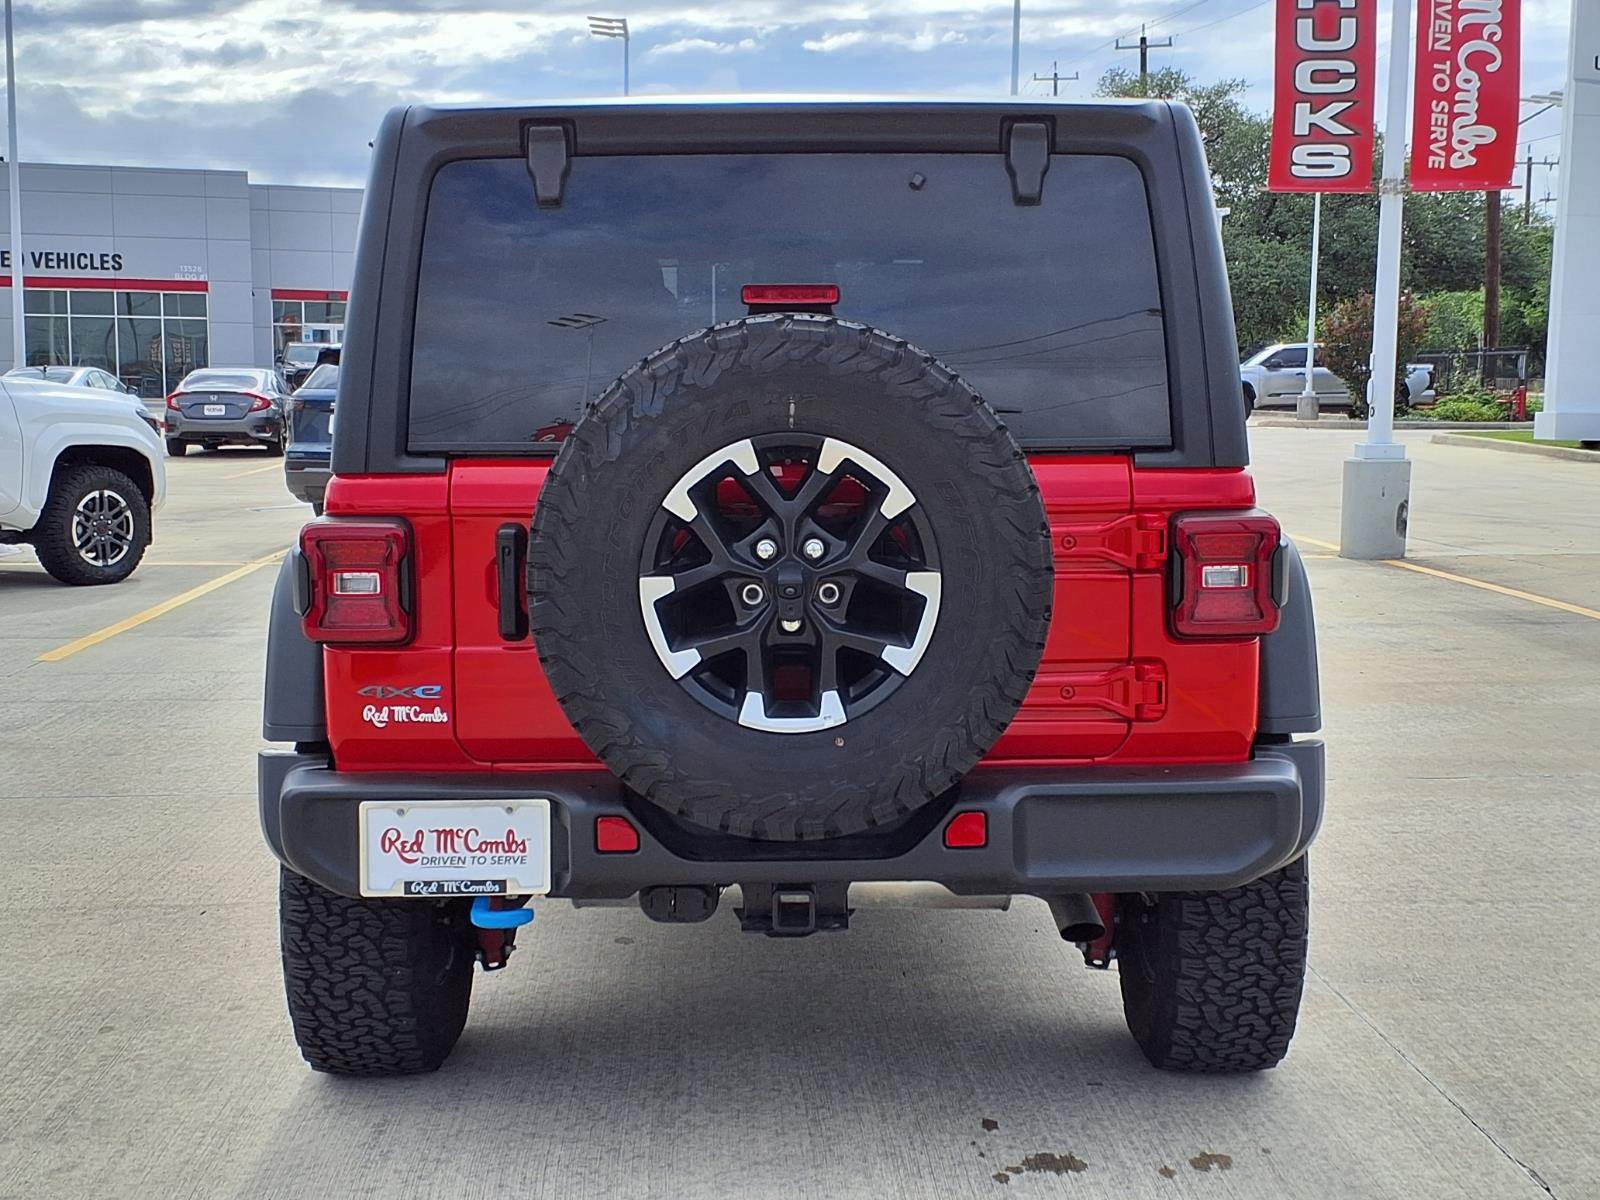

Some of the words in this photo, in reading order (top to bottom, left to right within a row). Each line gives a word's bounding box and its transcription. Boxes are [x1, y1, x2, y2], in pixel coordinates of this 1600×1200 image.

[1291, 0, 1360, 178] UCKS
[1432, 61, 1451, 92] TO
[1427, 100, 1449, 170] SERVE
[0, 250, 24, 268] E
[30, 251, 123, 271] VEHICLES
[362, 704, 389, 728] Red
[390, 705, 449, 723] McCombs
[380, 827, 425, 864] Red
[428, 828, 527, 854] McCombs
[420, 855, 467, 866] DRIVEN
[470, 855, 487, 866] TO
[491, 855, 528, 865] SERVE
[410, 881, 438, 895] Red
[439, 880, 500, 893] McCombs
